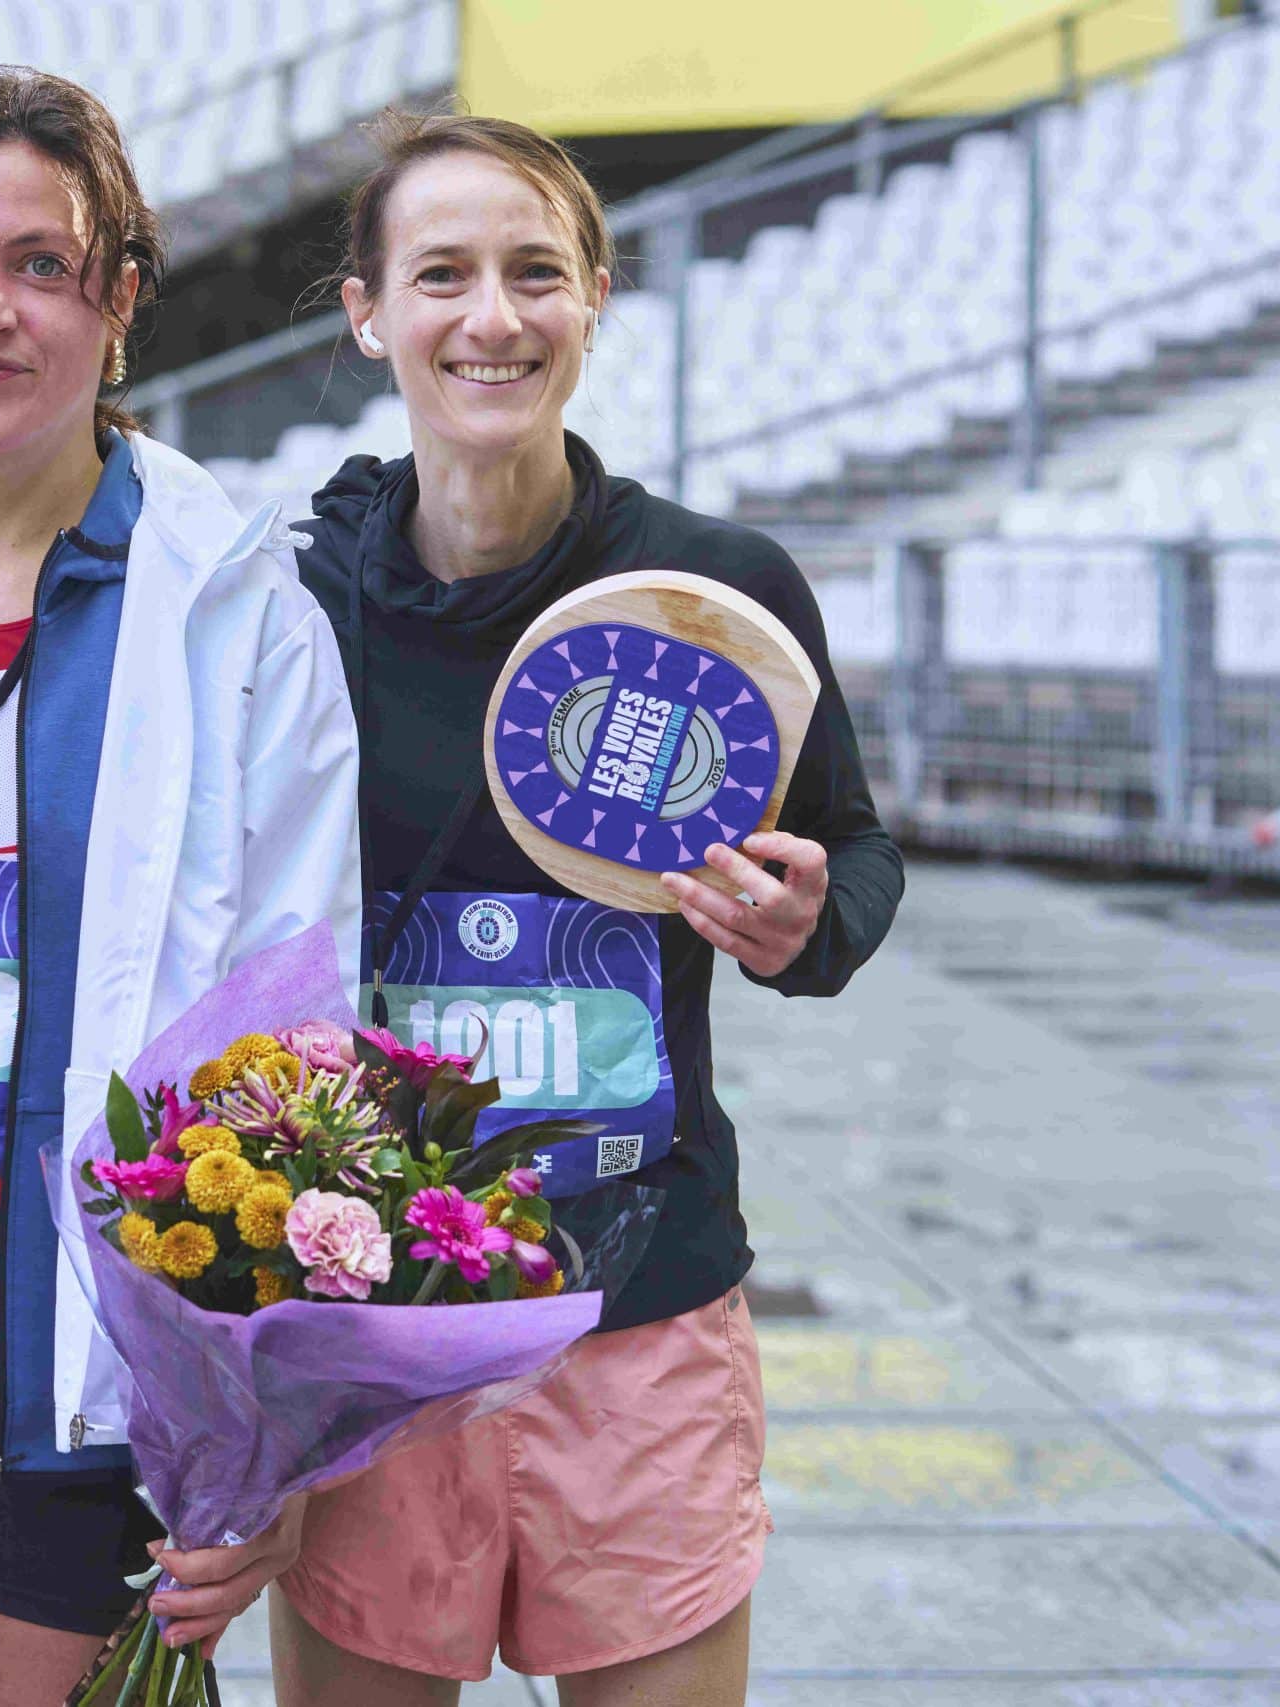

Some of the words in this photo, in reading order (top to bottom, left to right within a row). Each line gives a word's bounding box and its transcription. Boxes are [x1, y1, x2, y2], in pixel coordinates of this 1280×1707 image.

[552, 686, 582, 728] FEMME
[601, 688, 645, 755] VOIES
[616, 696, 673, 802] ROYALES
[655, 704, 688, 769] MARATHON
[588, 754, 622, 799] LES
[647, 768, 665, 796] SEMI
[707, 758, 726, 789] 2025
[641, 795, 656, 812] LE
